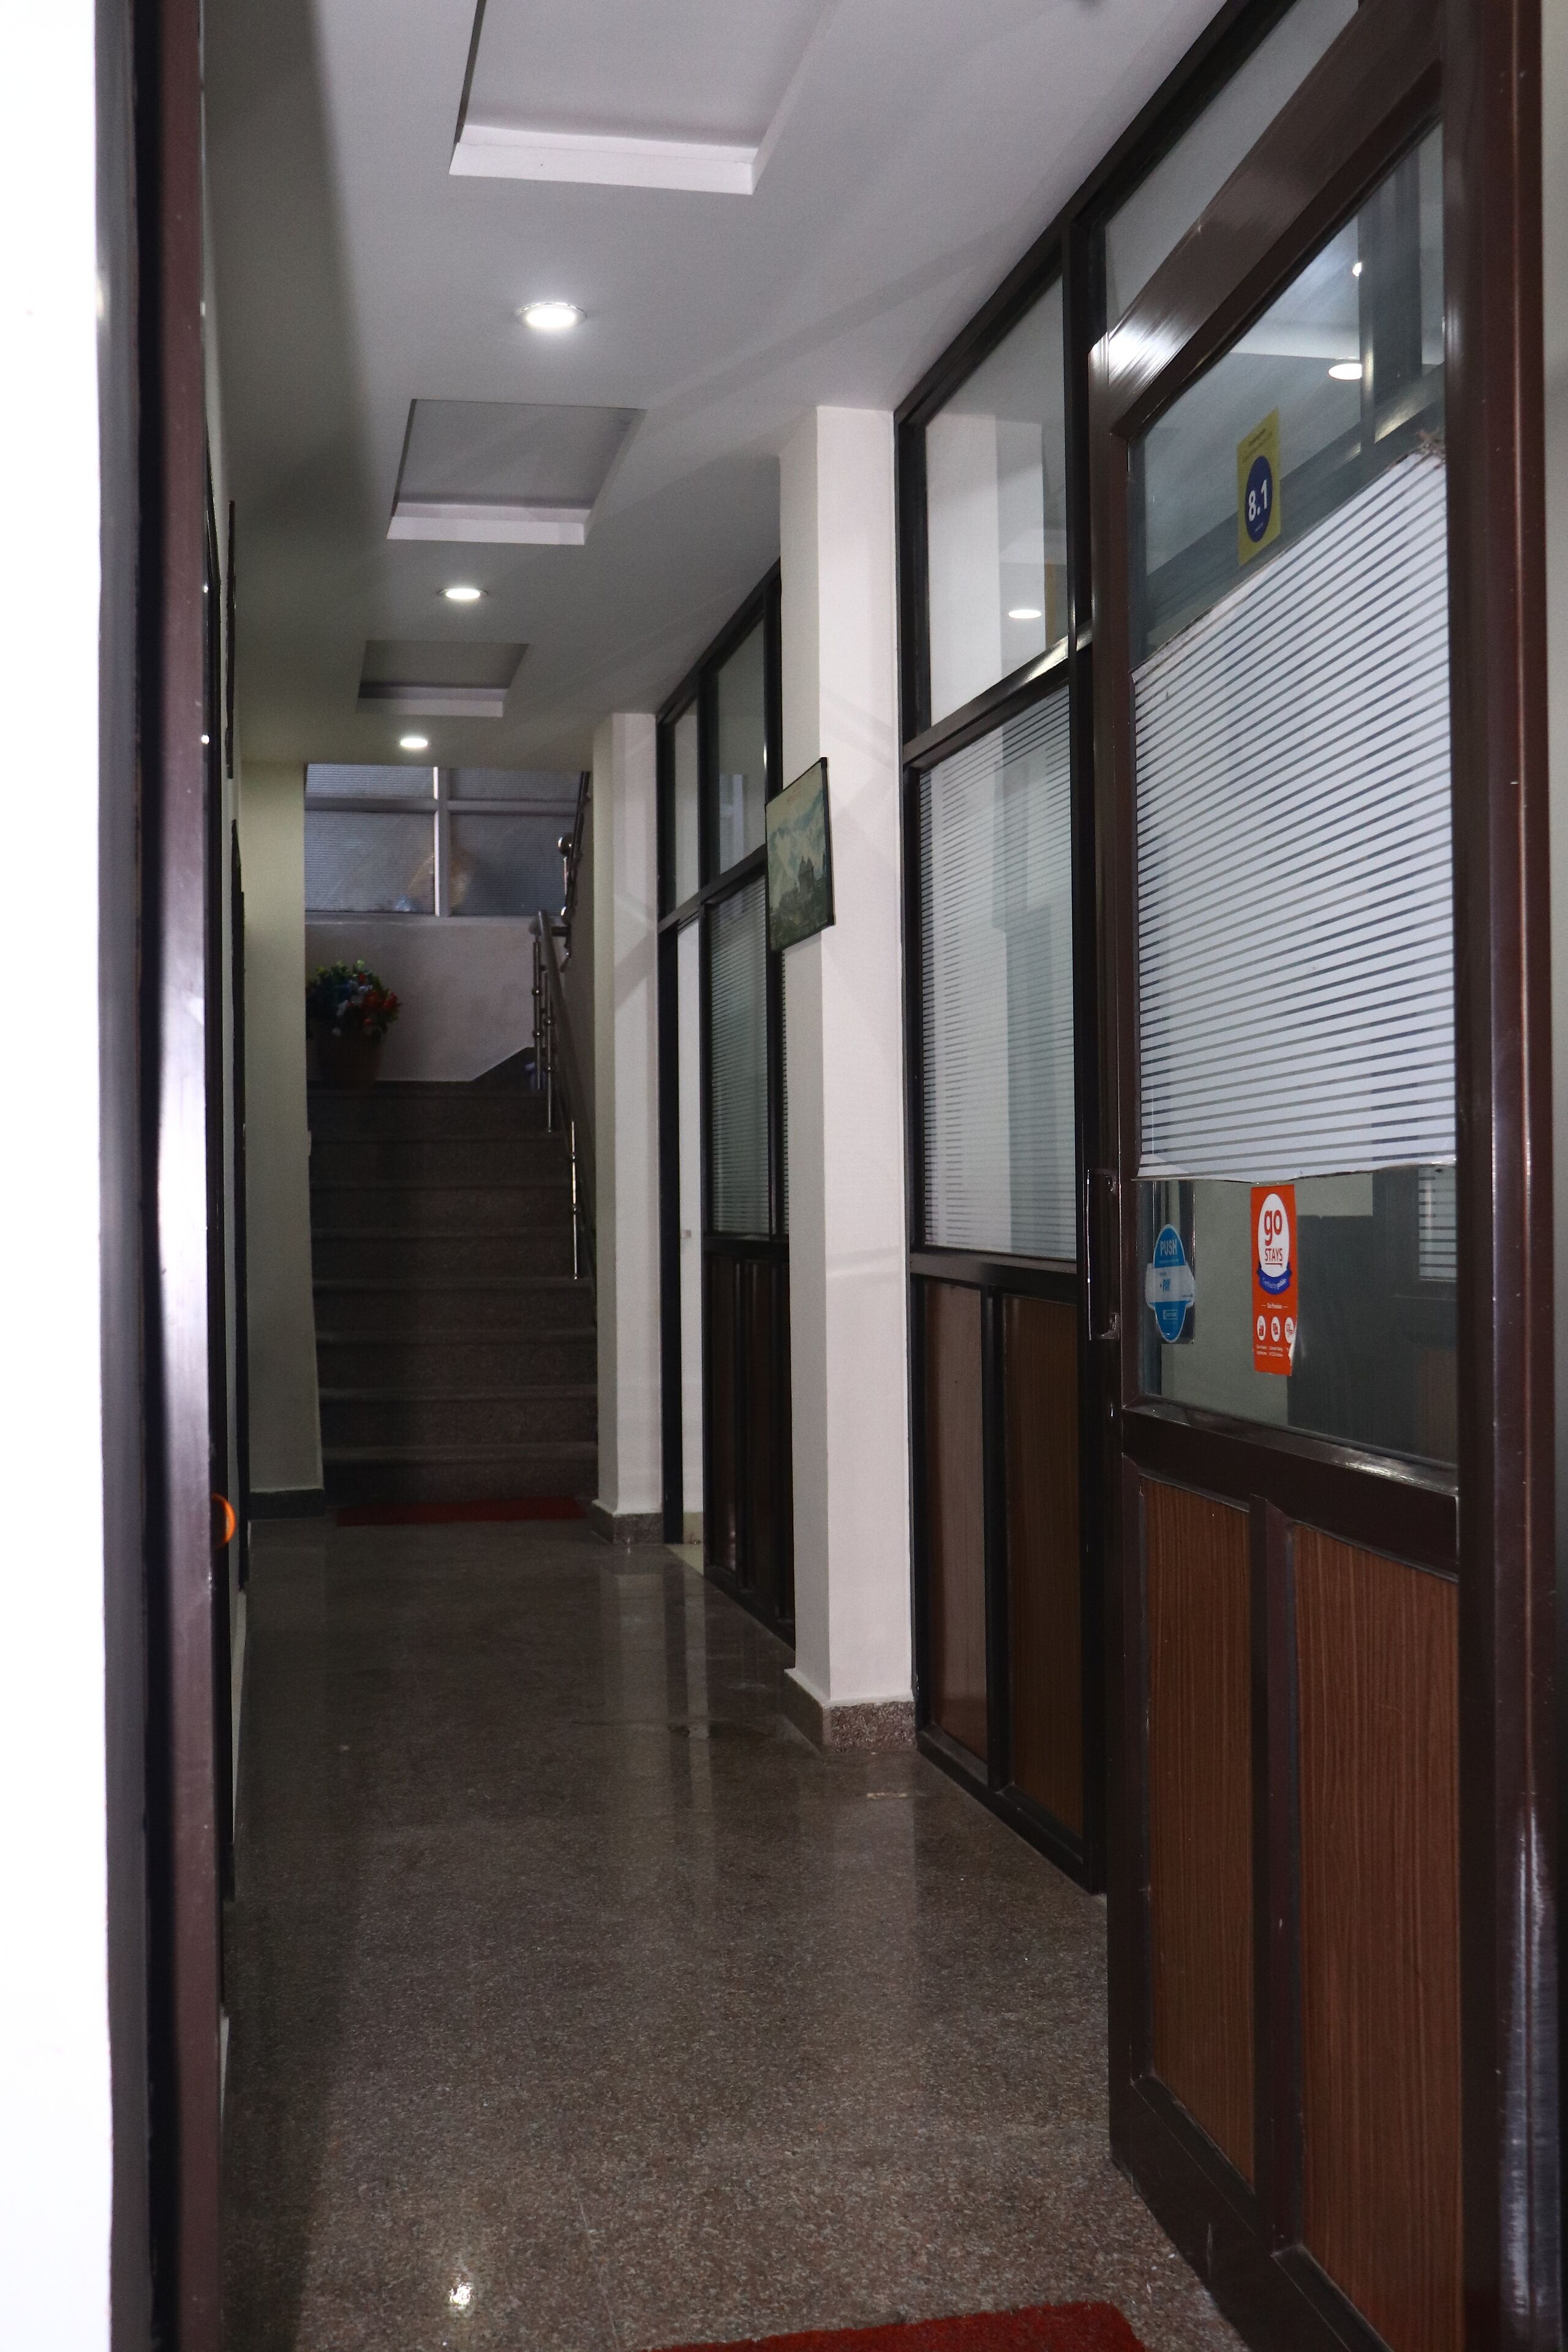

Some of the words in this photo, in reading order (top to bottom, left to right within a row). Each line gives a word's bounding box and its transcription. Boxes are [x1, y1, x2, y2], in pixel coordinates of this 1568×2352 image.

[1248, 479, 1267, 522] 8.1
[1264, 1210, 1282, 1246] go
[1160, 1238, 1177, 1256] PUSH
[1265, 1248, 1283, 1262] STAYS
